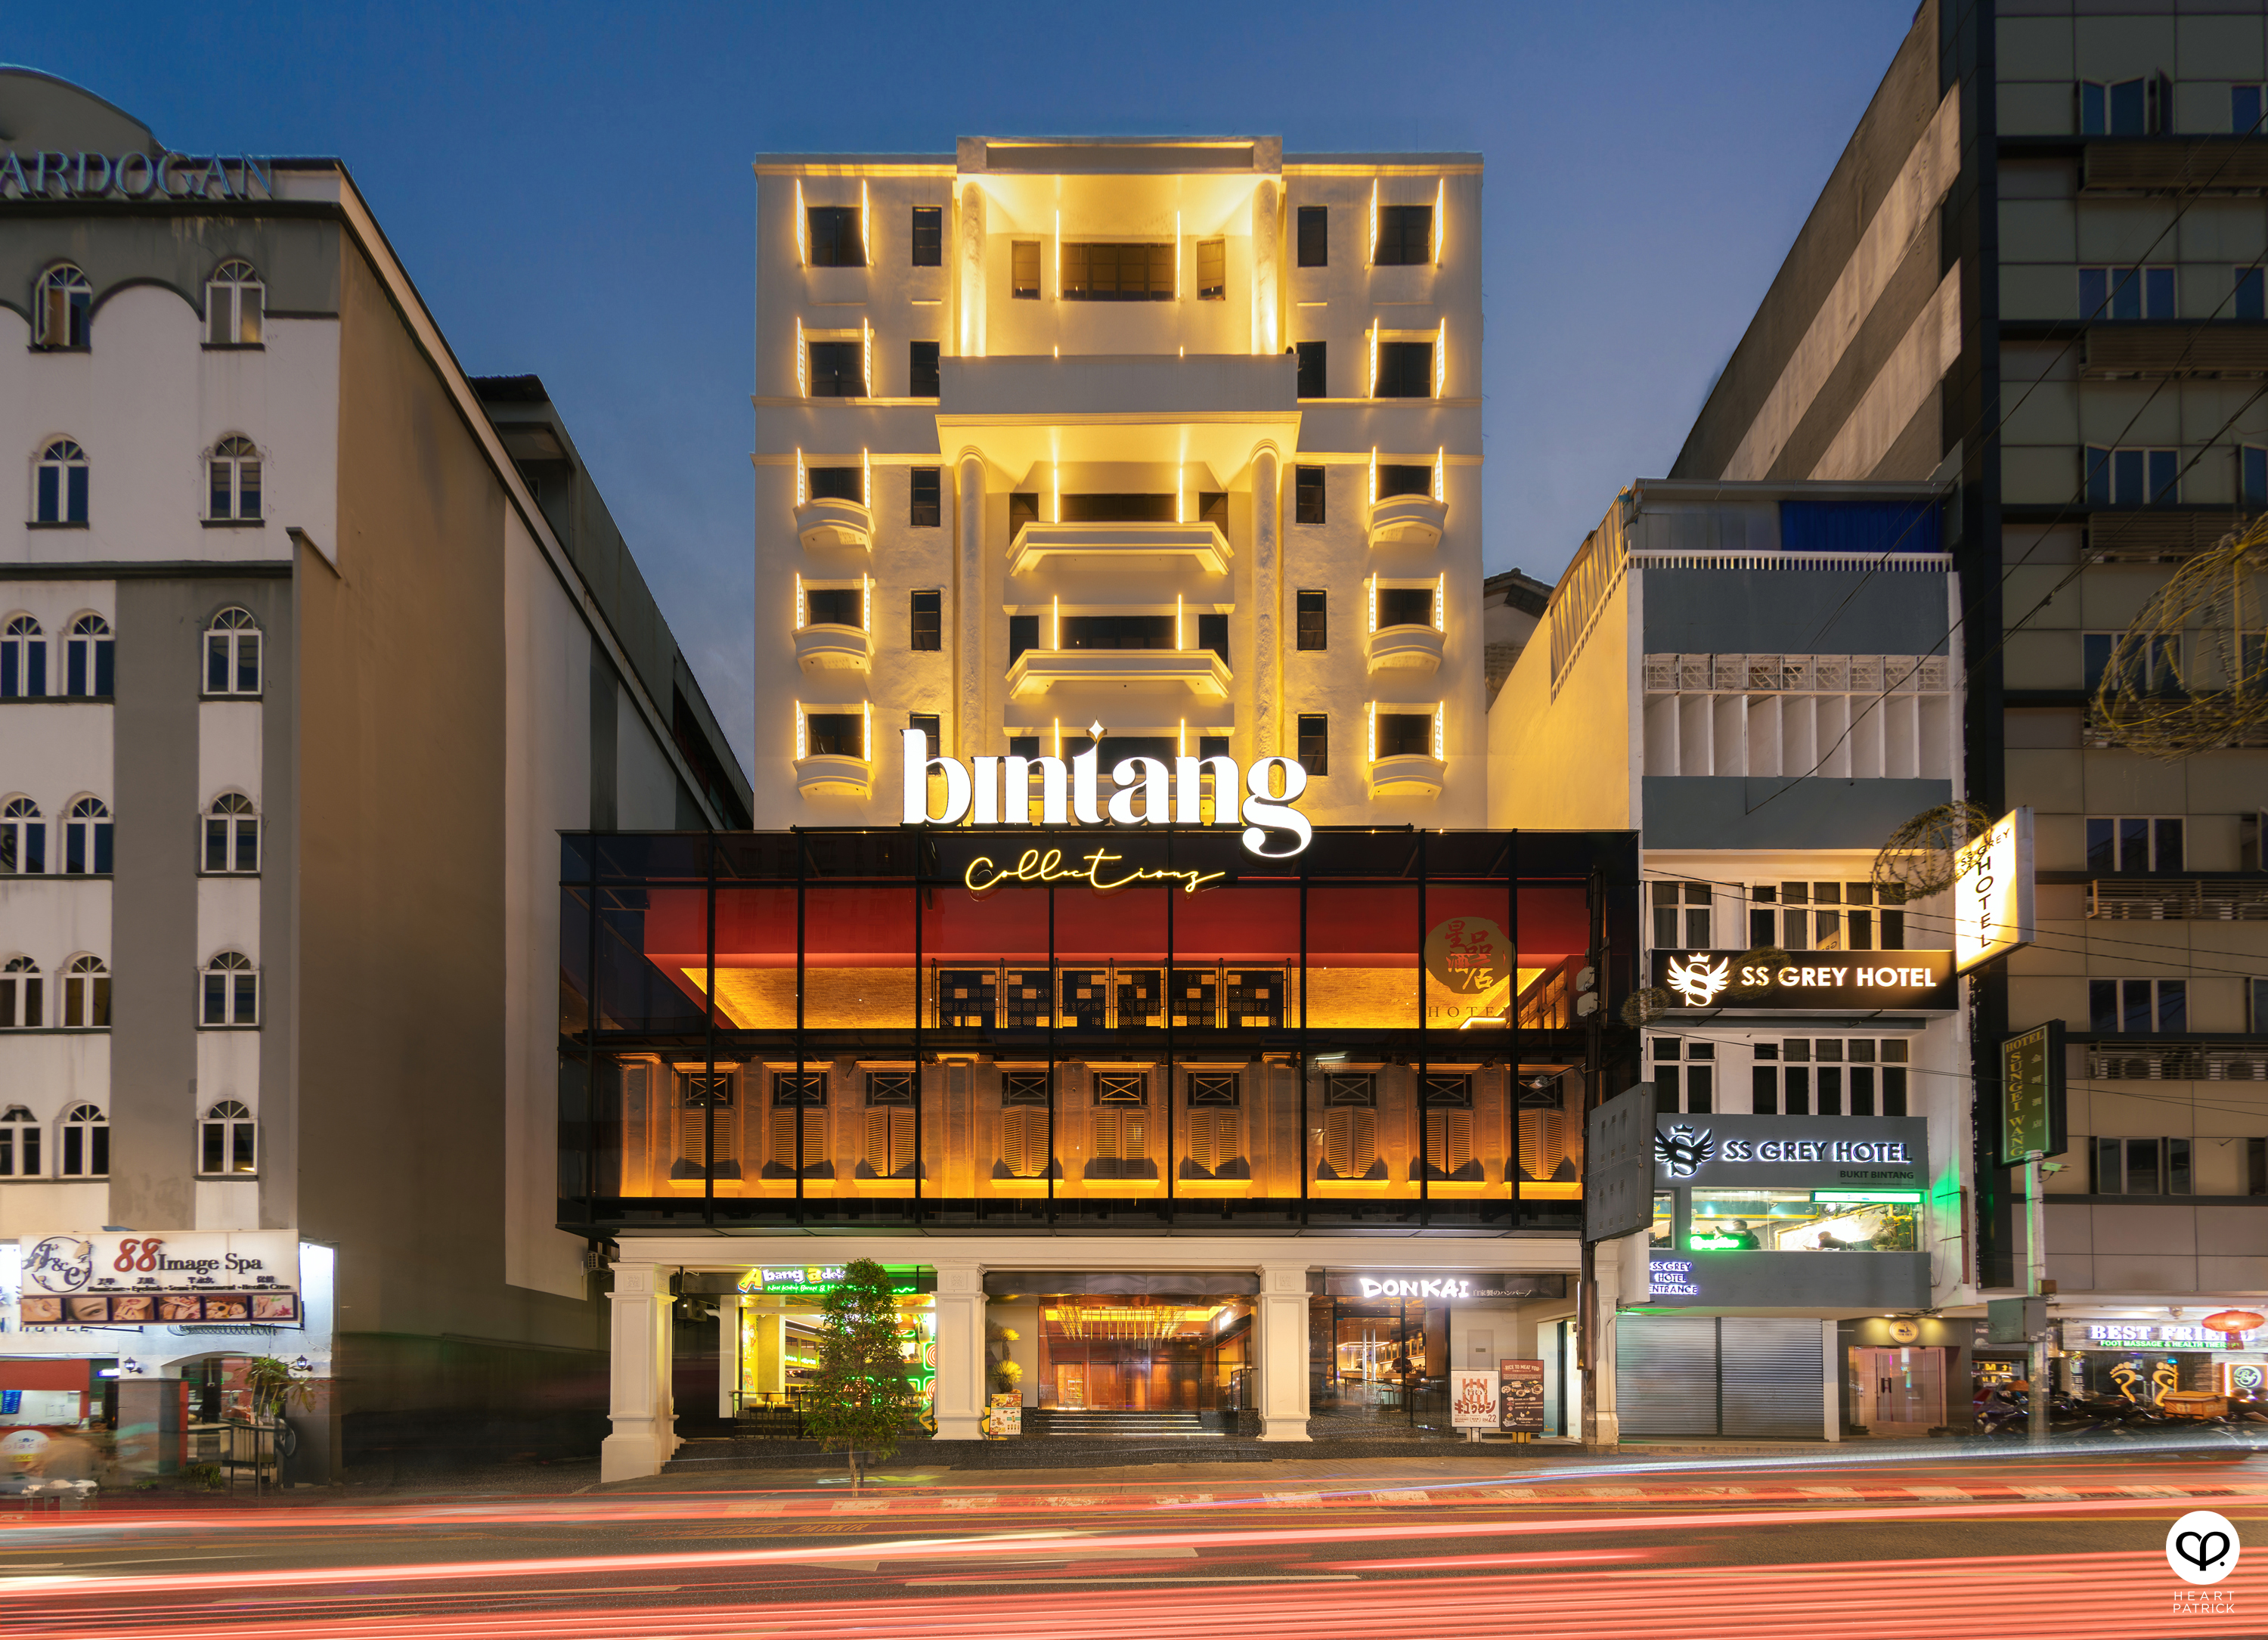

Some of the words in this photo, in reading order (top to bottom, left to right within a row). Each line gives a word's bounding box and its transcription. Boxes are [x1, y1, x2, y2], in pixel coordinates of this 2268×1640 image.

[900, 716, 1312, 857] bintang
[1977, 827, 2010, 855] GREY
[1975, 856, 1994, 948] HOTEL
[1741, 966, 1770, 987] SS
[1778, 967, 1848, 987] GREY
[1857, 967, 1937, 987] HOTEL
[2006, 1031, 2044, 1053] HOTEL
[2009, 1051, 2025, 1112] SUNGEI
[2009, 1115, 2026, 1157] WANG
[1724, 1140, 1753, 1161] SS
[1759, 1141, 1828, 1161] GREY
[1835, 1142, 1913, 1162] HOTEL
[113, 1238, 163, 1272] 88
[158, 1253, 219, 1275] Image
[225, 1252, 263, 1274] Spa
[1652, 1262, 1663, 1270] SS
[1665, 1262, 1692, 1270] GREY
[1658, 1273, 1687, 1282] HOTEL
[2090, 1325, 2152, 1341] BEST
[2160, 1325, 2256, 1341] FRIED
